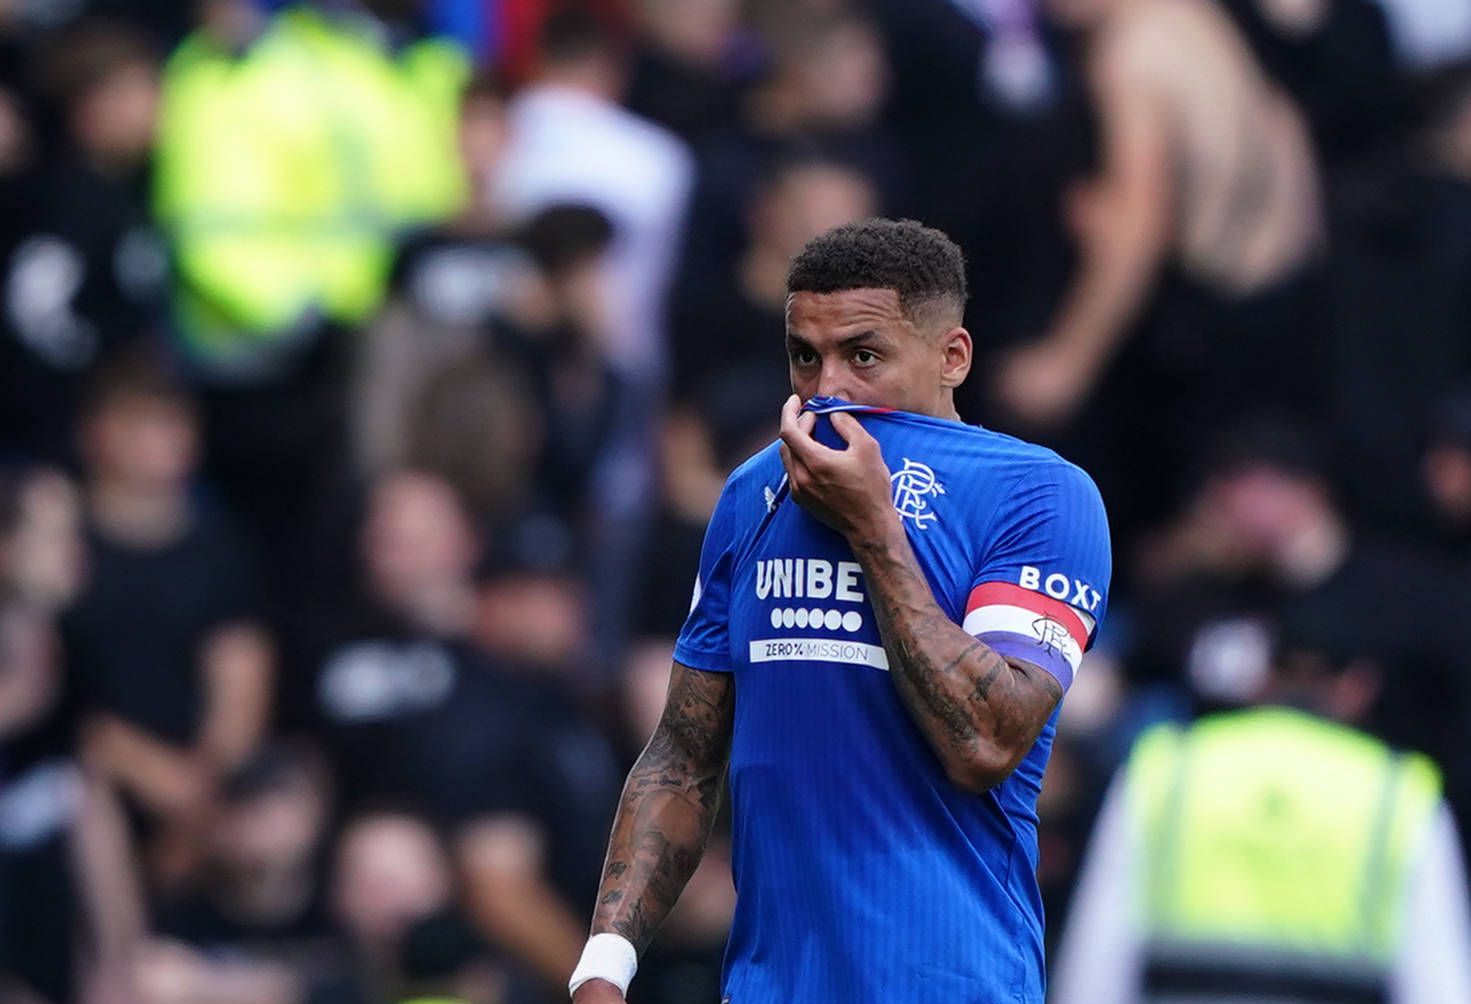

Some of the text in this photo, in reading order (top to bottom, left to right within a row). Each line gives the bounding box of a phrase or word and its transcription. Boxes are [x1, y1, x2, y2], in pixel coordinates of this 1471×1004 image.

[755, 558, 864, 602] UNIBE
[1019, 565, 1102, 610] BOXT
[806, 643, 868, 660] MISSION
